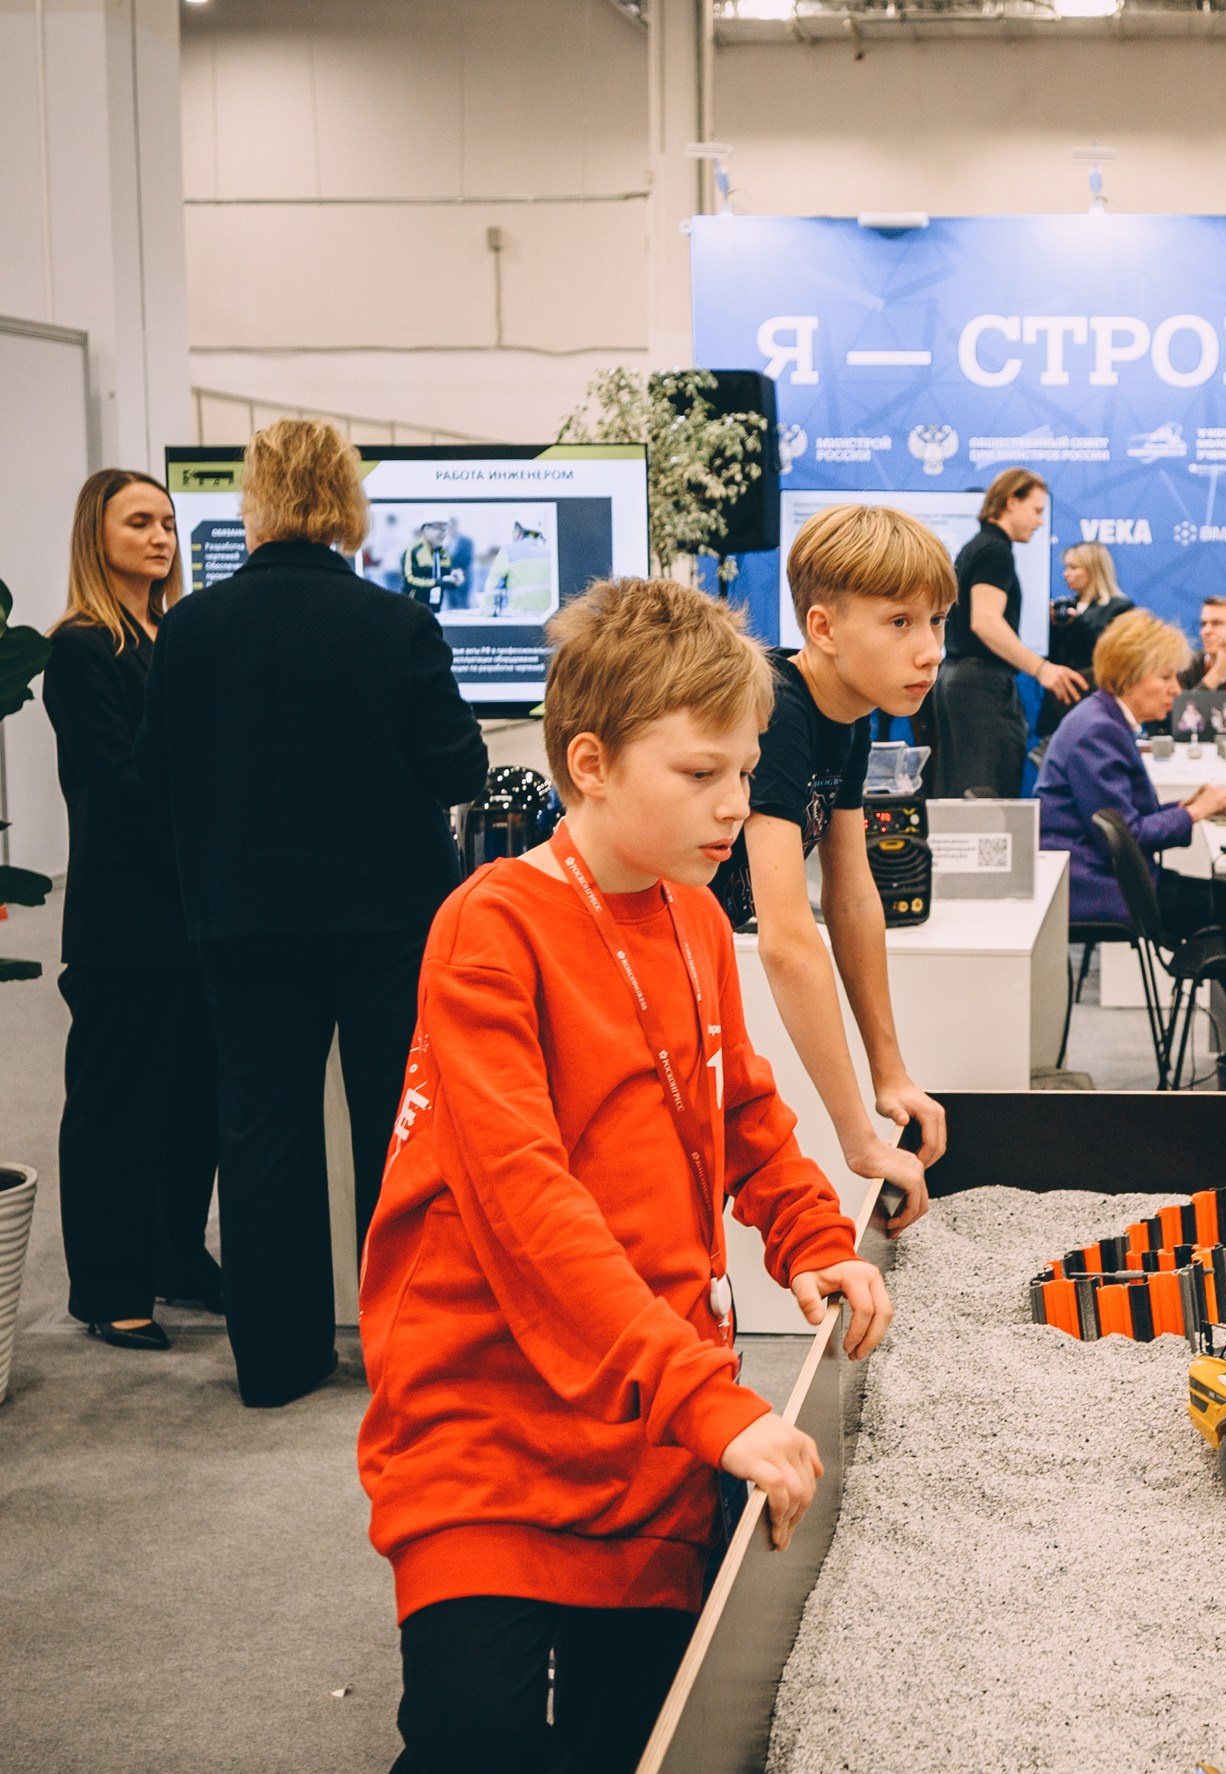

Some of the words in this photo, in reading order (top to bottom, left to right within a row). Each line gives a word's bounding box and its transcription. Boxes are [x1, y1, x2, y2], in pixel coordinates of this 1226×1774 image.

[757, 315, 820, 385] Я
[436, 469, 484, 480] РАБОТА
[489, 469, 574, 480] ИНЖЕНЕРОМ
[1080, 519, 1152, 544] VEKA
